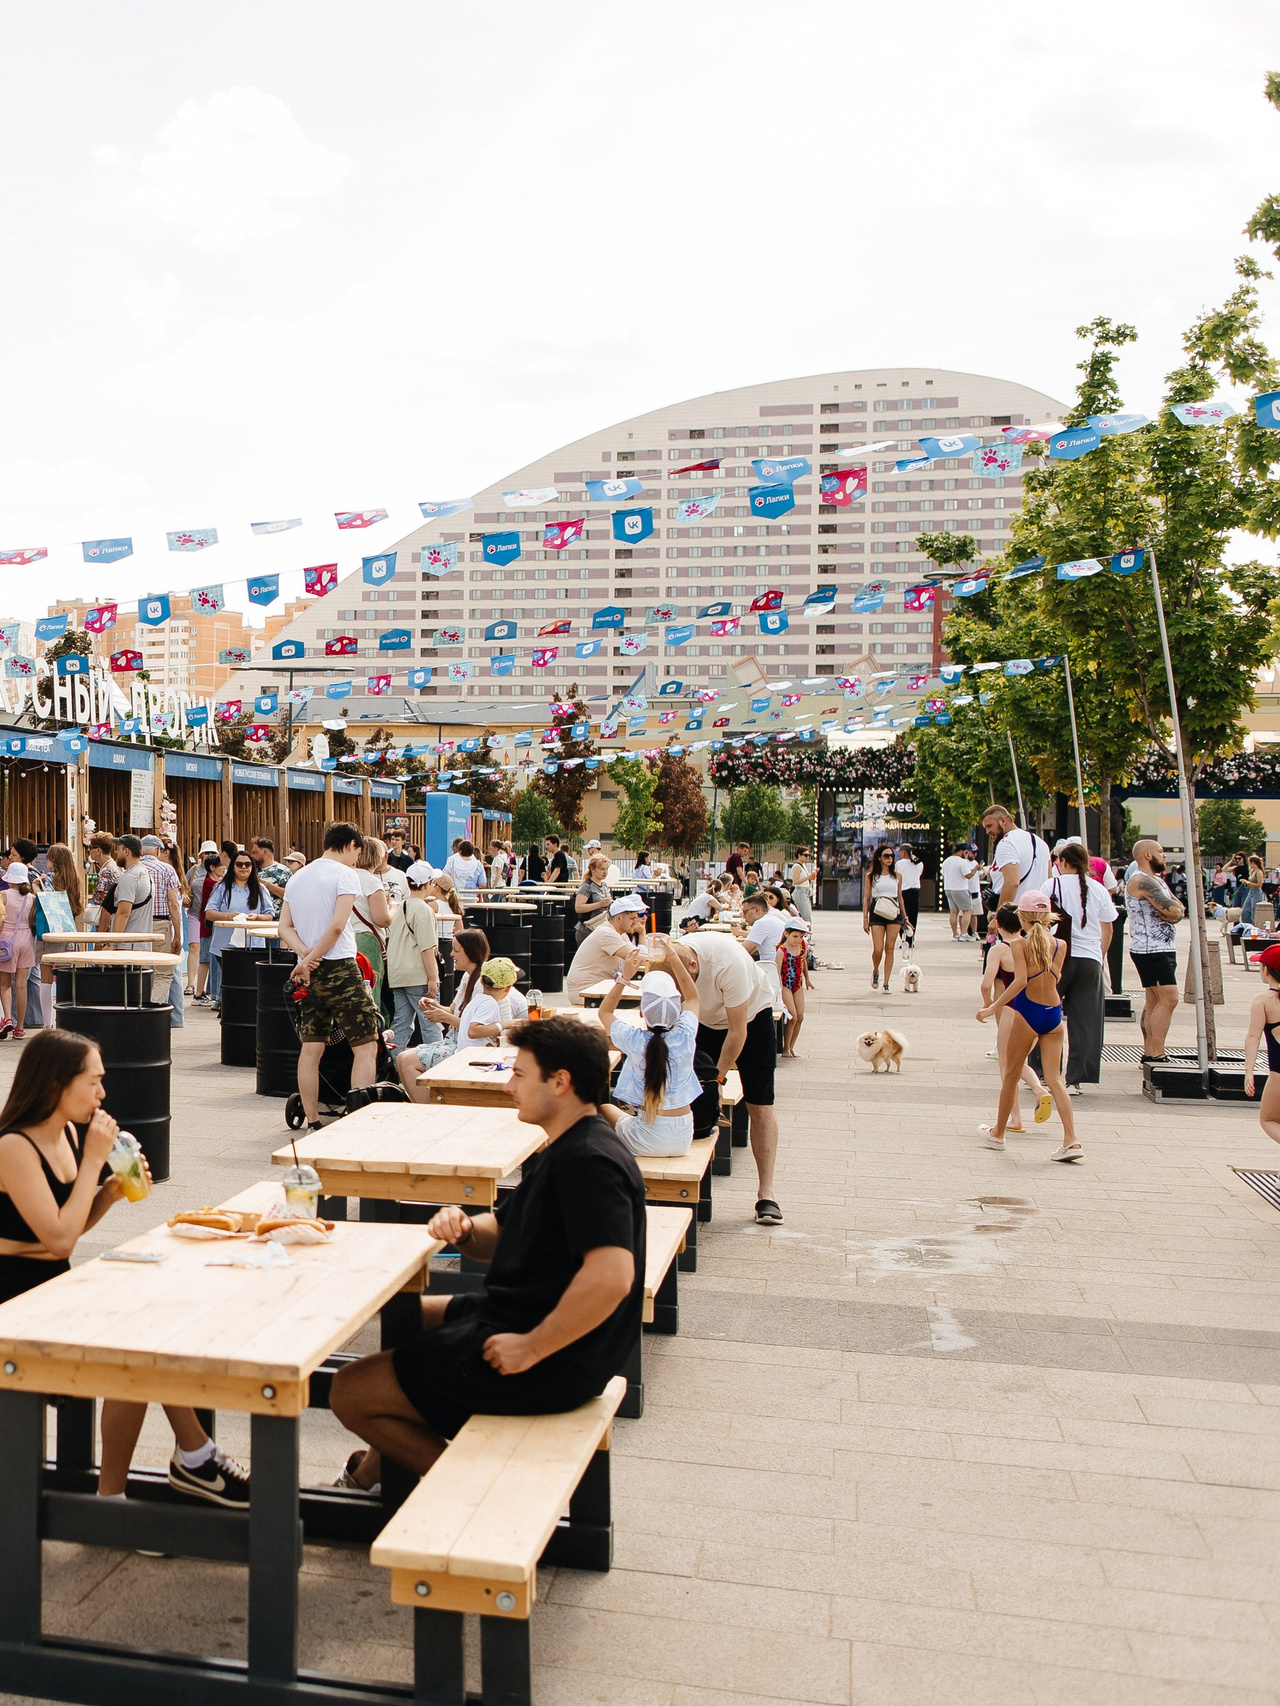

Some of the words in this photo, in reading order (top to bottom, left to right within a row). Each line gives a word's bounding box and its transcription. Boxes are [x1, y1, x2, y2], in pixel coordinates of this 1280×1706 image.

[1113, 415, 1141, 426] Лапки
[943, 440, 959, 448] VK
[1069, 435, 1096, 447] Лапки
[775, 462, 804, 473] Лапки
[765, 494, 790, 504] Лапки
[440, 500, 468, 509] Лапки
[628, 520, 639, 529] VK
[101, 545, 129, 555] Лапки
[497, 543, 517, 552] Лапки
[1123, 556, 1132, 564] VK
[374, 565, 384, 573] VK
[260, 585, 277, 594] Лапки
[46, 623, 64, 631] Лапки
